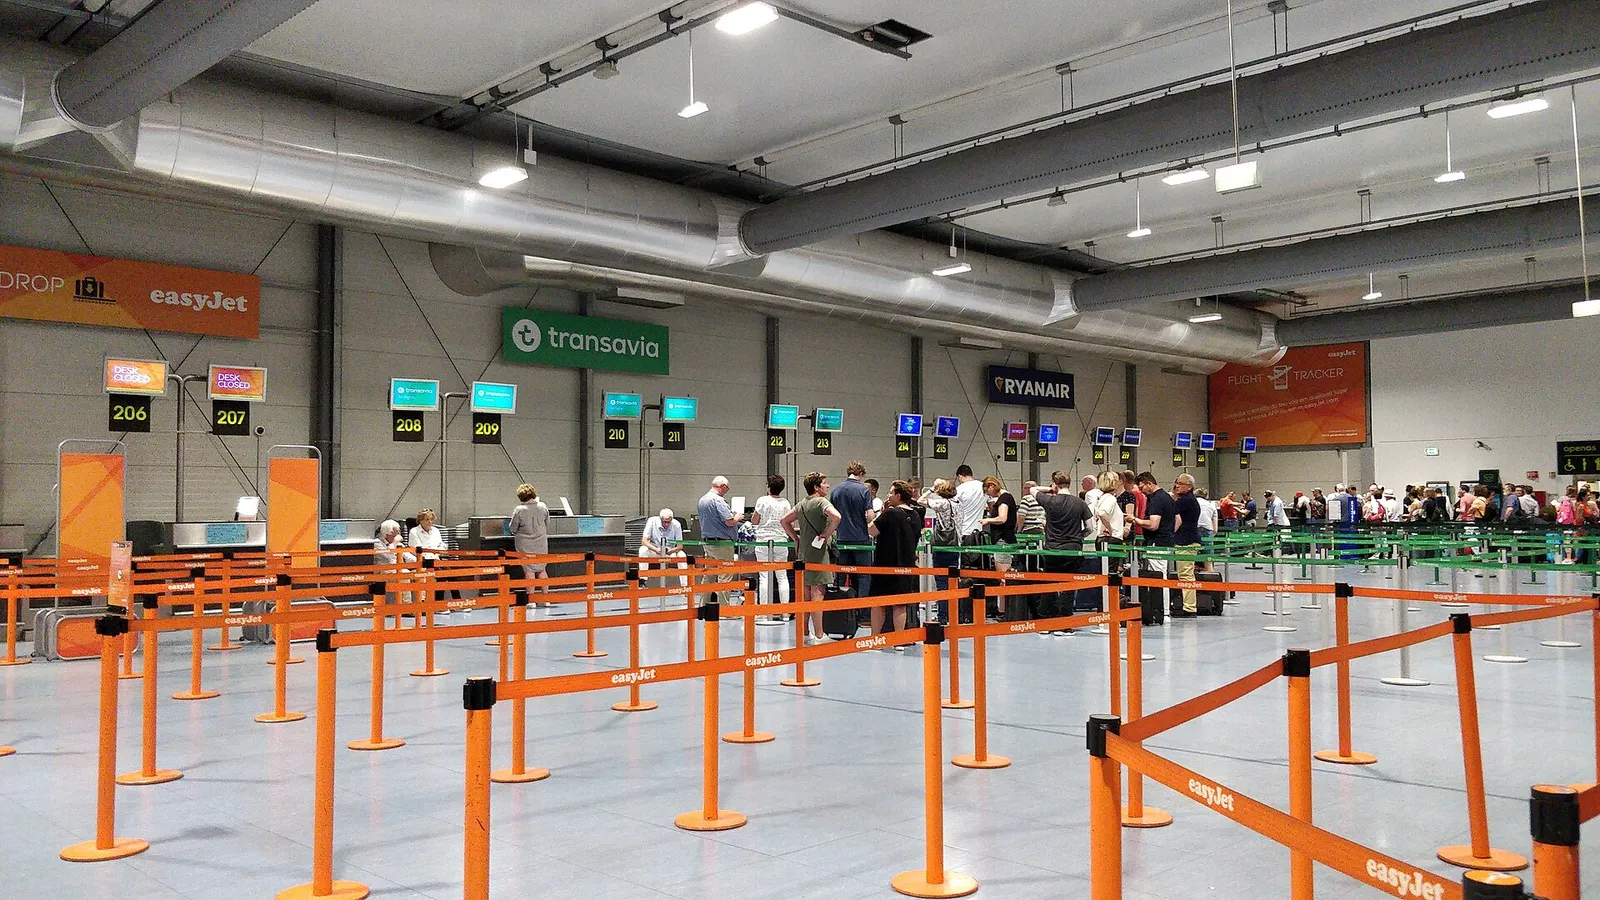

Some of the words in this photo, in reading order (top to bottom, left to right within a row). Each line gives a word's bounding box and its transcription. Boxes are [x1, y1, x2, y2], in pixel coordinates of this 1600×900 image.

[0, 272, 65, 293] DROP
[149, 289, 248, 312] easyJet
[547, 326, 660, 358] transavia
[1327, 349, 1357, 358] easyJet
[114, 366, 138, 374] DESK
[218, 373, 240, 382] DESK
[1228, 373, 1264, 385] FLIGHT
[1293, 367, 1344, 380] TRACKER
[217, 381, 251, 389] CLOSED
[1004, 378, 1070, 399] RYANAIR
[113, 405, 147, 421] 206
[217, 411, 246, 425] 207
[396, 419, 422, 432] 208
[475, 423, 499, 435] 209
[608, 428, 625, 440] 210
[668, 431, 681, 442] 211
[770, 436, 783, 447] 212
[816, 438, 829, 448] 213
[898, 441, 909, 451] 214
[936, 444, 946, 453] 215
[1563, 445, 1597, 453] apenas
[255, 576, 278, 585] easyJe
[168, 582, 195, 590] easyJet
[669, 586, 692, 594] easyJet
[1266, 584, 1295, 592] easyJet
[587, 592, 613, 600] easyJet
[1434, 593, 1468, 602] easyJet
[447, 599, 477, 608] easyJet
[343, 607, 376, 617] easyJet
[225, 615, 263, 624] easyJet
[1088, 613, 1110, 623] easyJet
[1010, 621, 1036, 632] easyJet
[856, 636, 886, 649] easyJet
[745, 653, 782, 667] easyJet
[611, 669, 656, 684] easyJet
[1188, 778, 1235, 812] easyJet
[1366, 858, 1445, 900] easyJet
